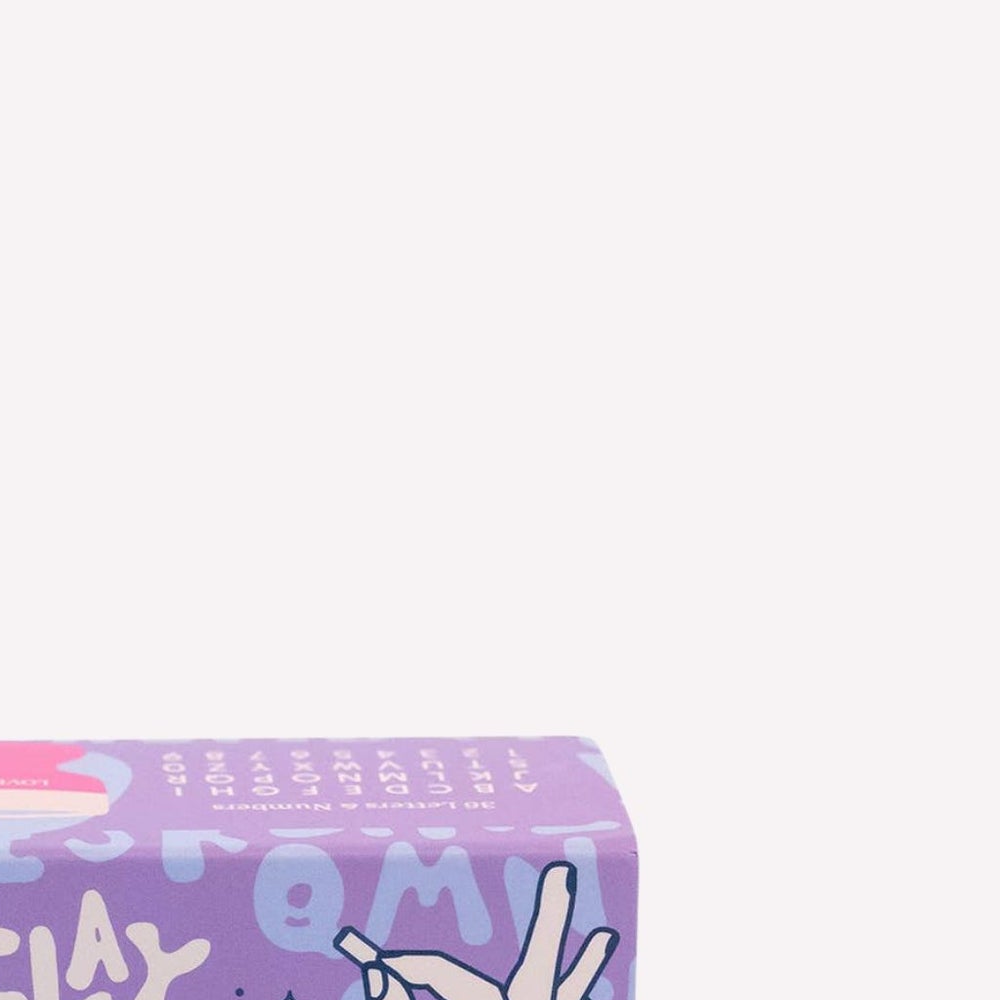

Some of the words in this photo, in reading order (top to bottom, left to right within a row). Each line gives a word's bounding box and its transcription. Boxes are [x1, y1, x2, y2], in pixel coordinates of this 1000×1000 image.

[212, 803, 332, 811] Numbers
[366, 801, 456, 810] Letters
[464, 801, 495, 810] 36
